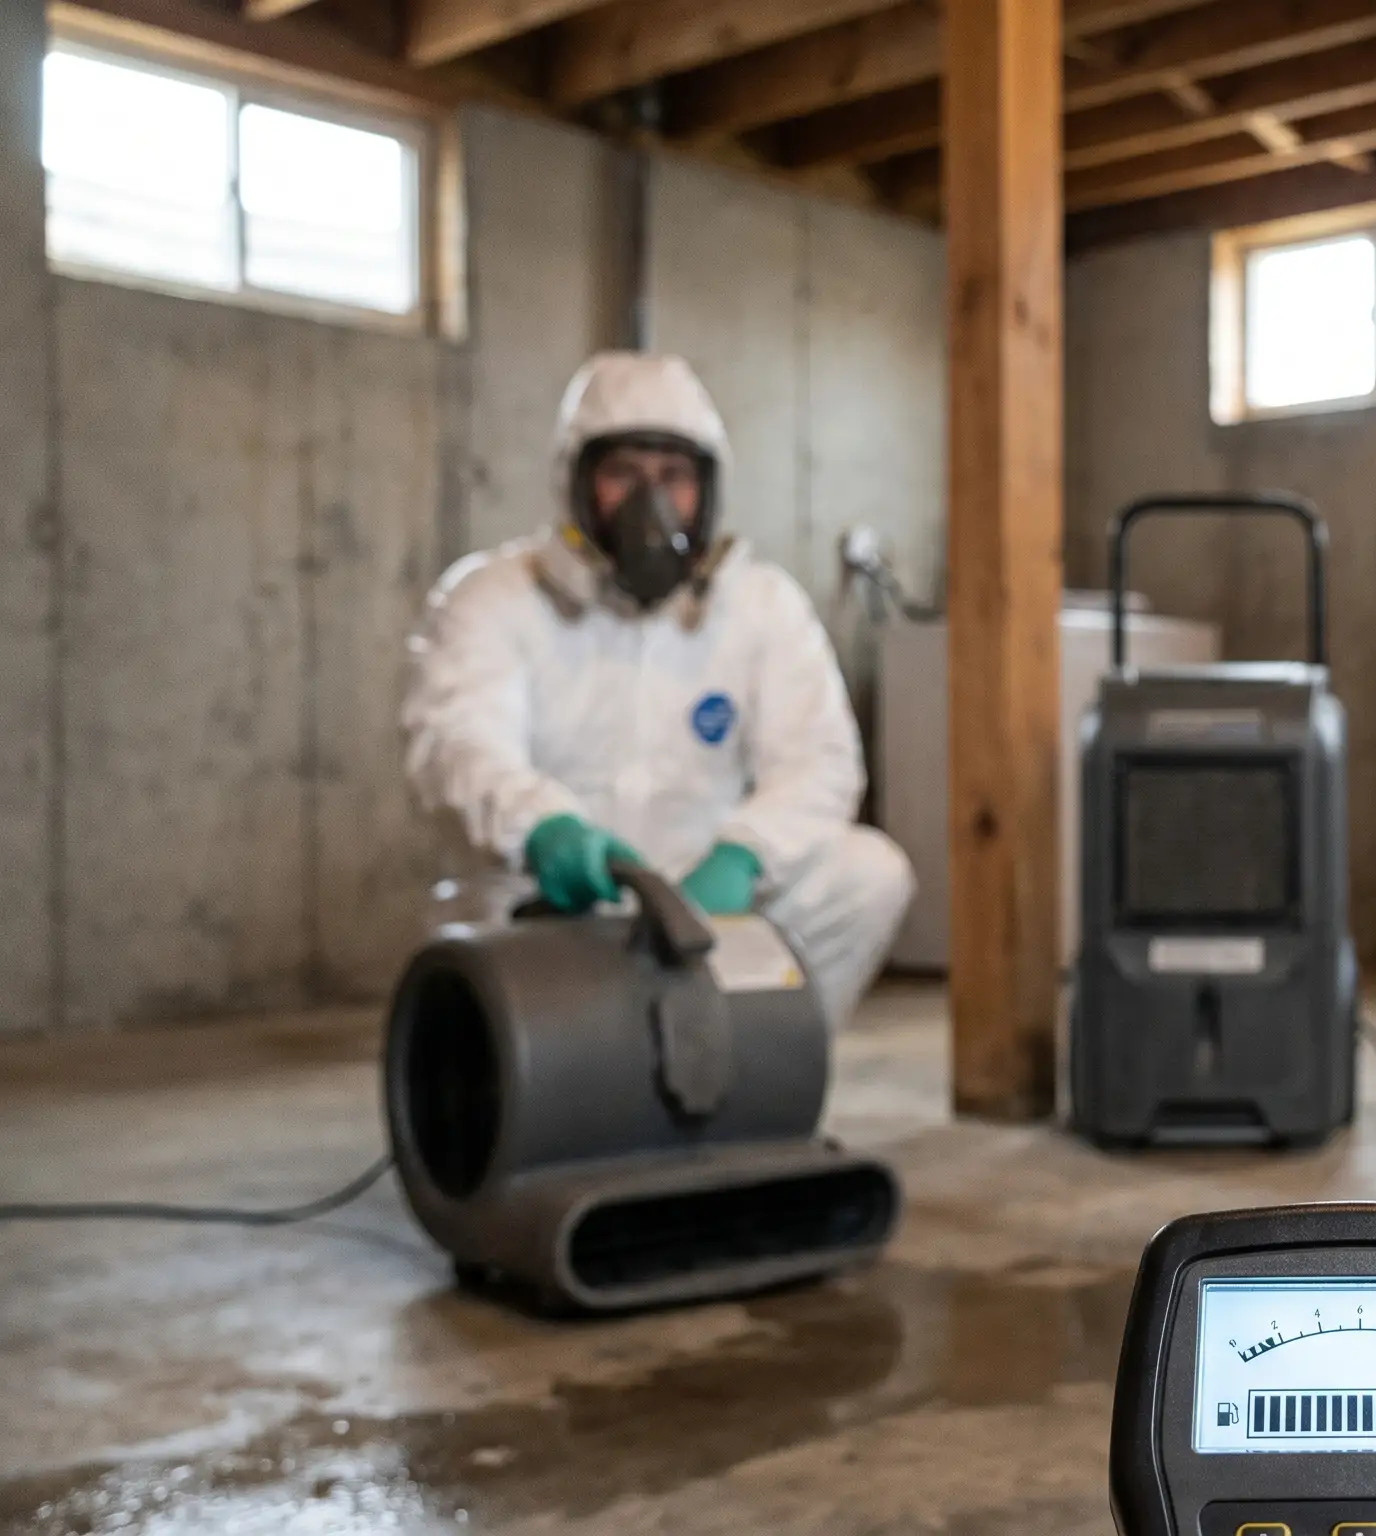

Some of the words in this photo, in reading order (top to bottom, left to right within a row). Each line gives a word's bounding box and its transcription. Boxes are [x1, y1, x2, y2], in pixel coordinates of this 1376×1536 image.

[1270, 1320, 1278, 1330] 2
[1314, 1308, 1321, 1318] 4
[1357, 1305, 1363, 1314] 6
